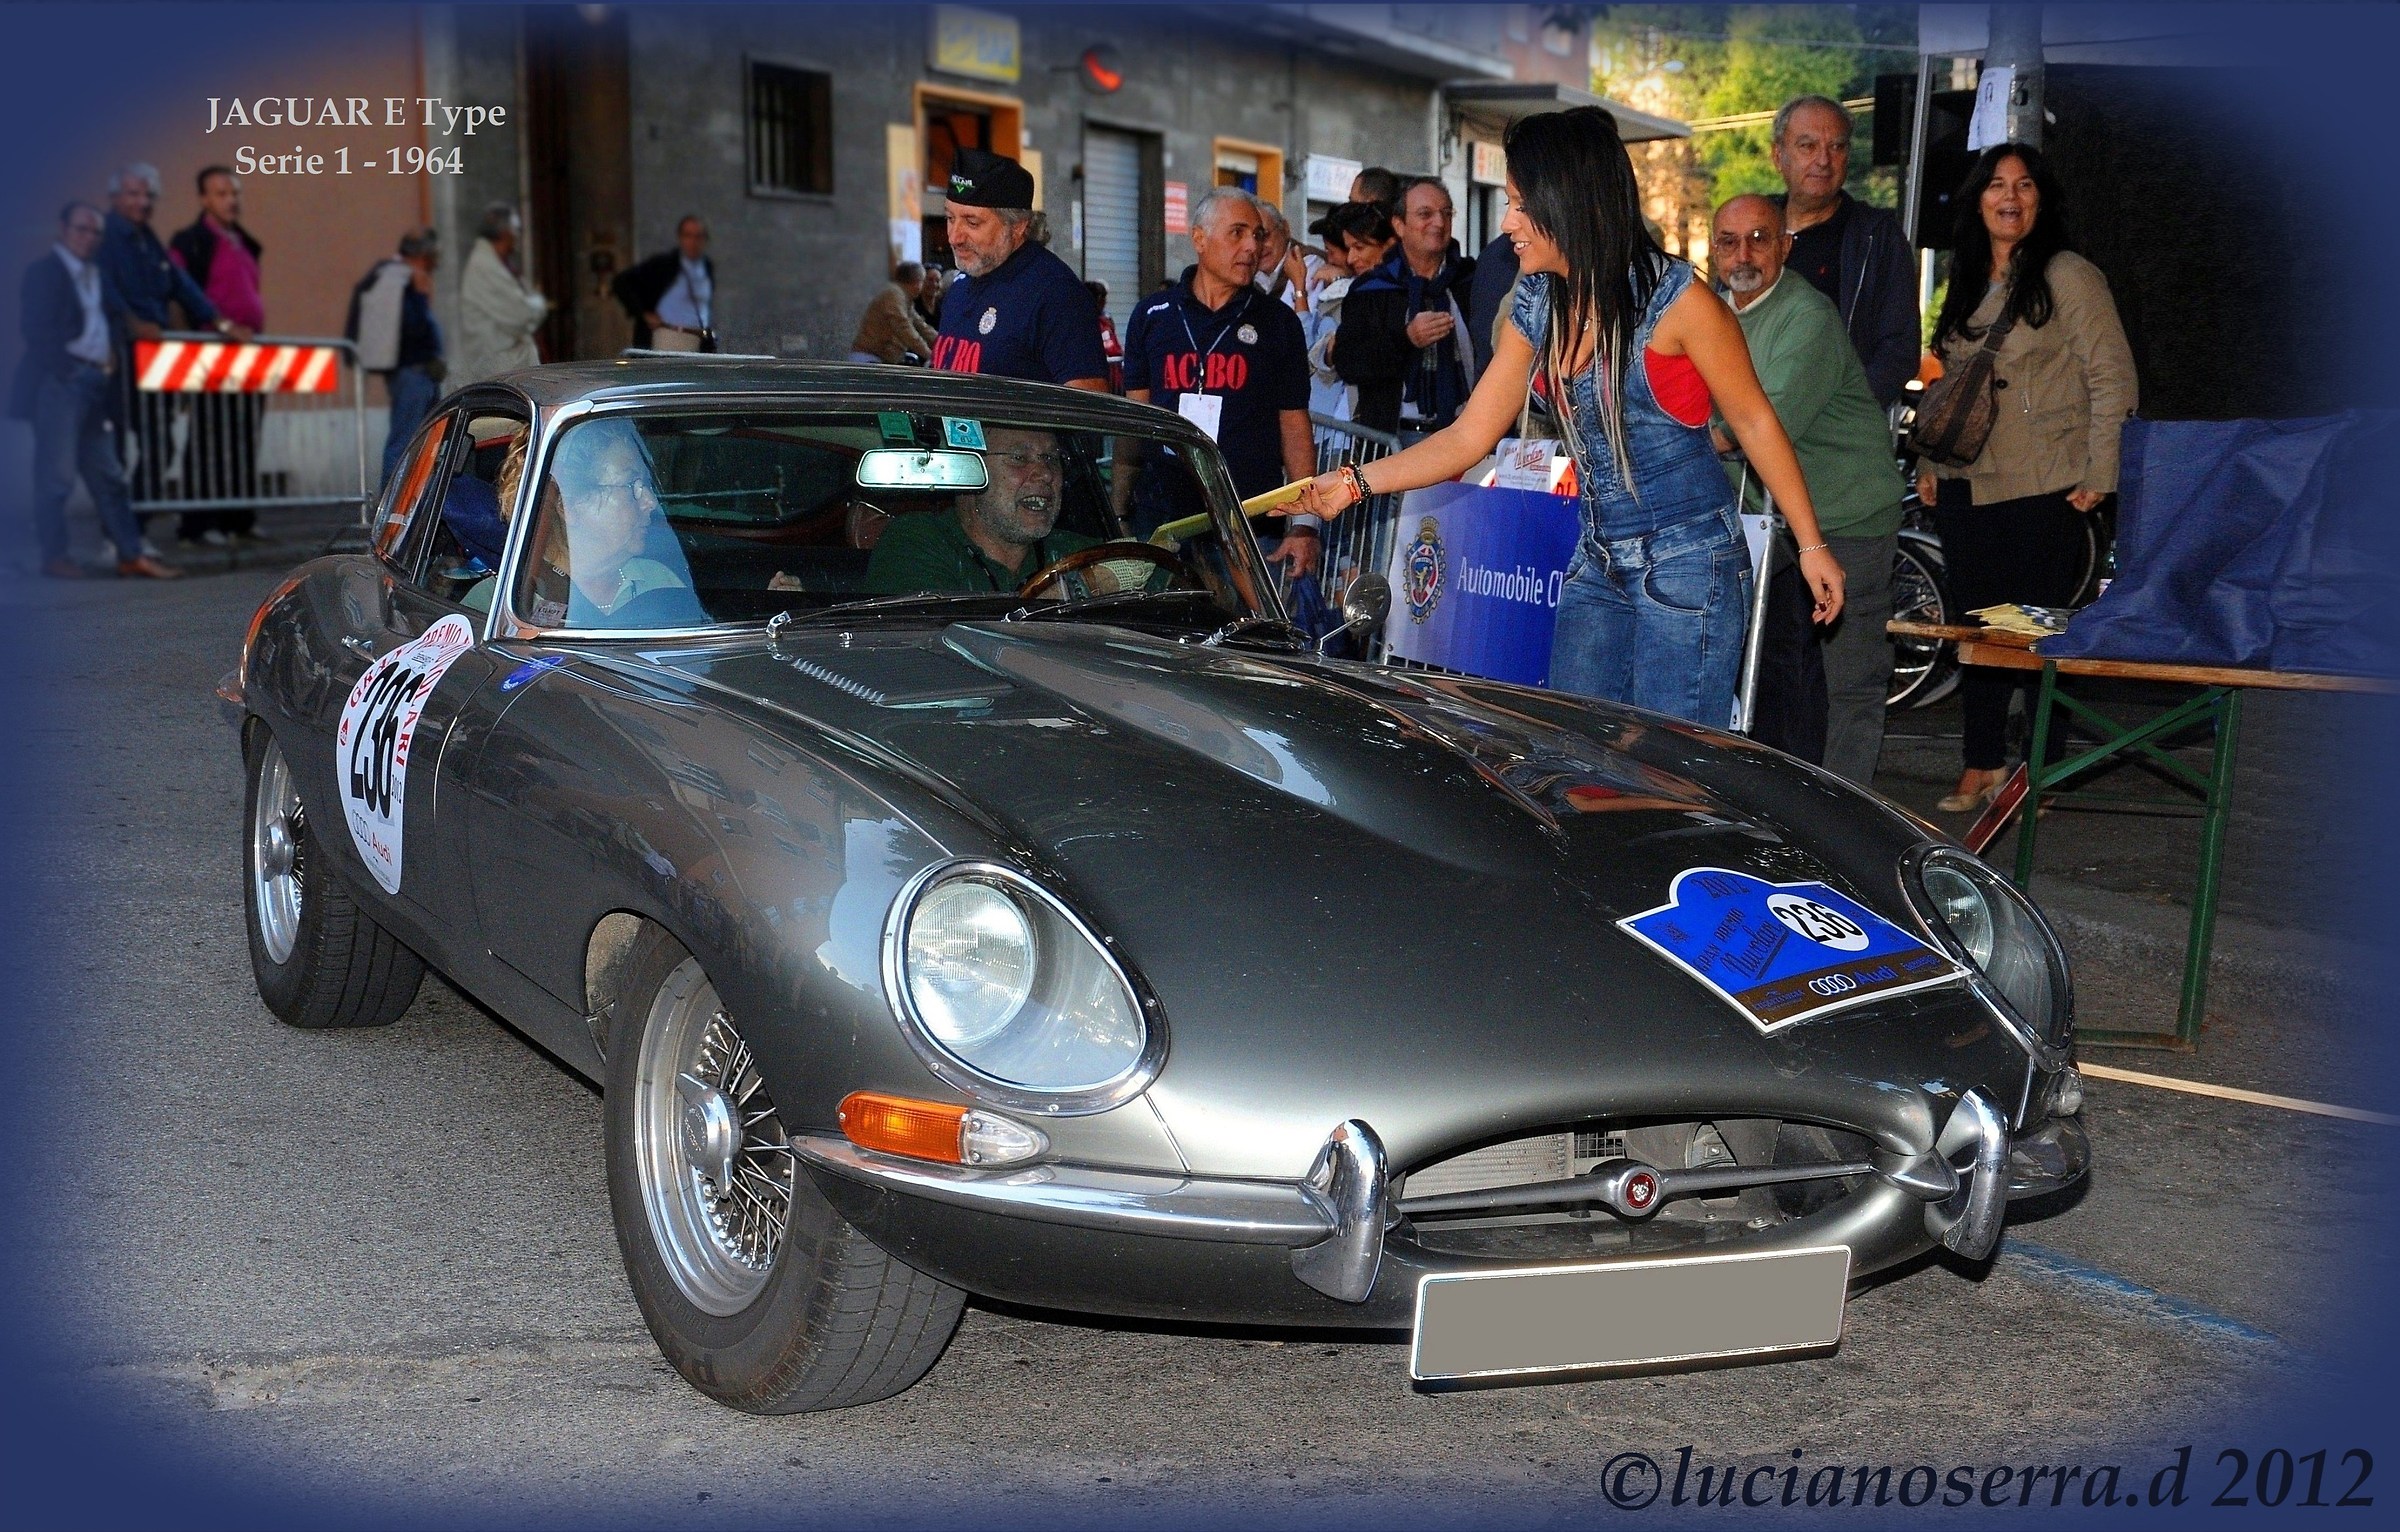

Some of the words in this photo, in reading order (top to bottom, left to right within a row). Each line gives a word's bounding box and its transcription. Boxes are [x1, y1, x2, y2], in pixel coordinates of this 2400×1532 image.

[1163, 353, 1198, 390] AC
[1205, 353, 1248, 390] BO
[1457, 556, 1543, 605] Automobile
[350, 660, 426, 819] 236
[371, 832, 393, 866] Audi
[1772, 901, 1863, 943] 236
[1852, 964, 1899, 986] Audi
